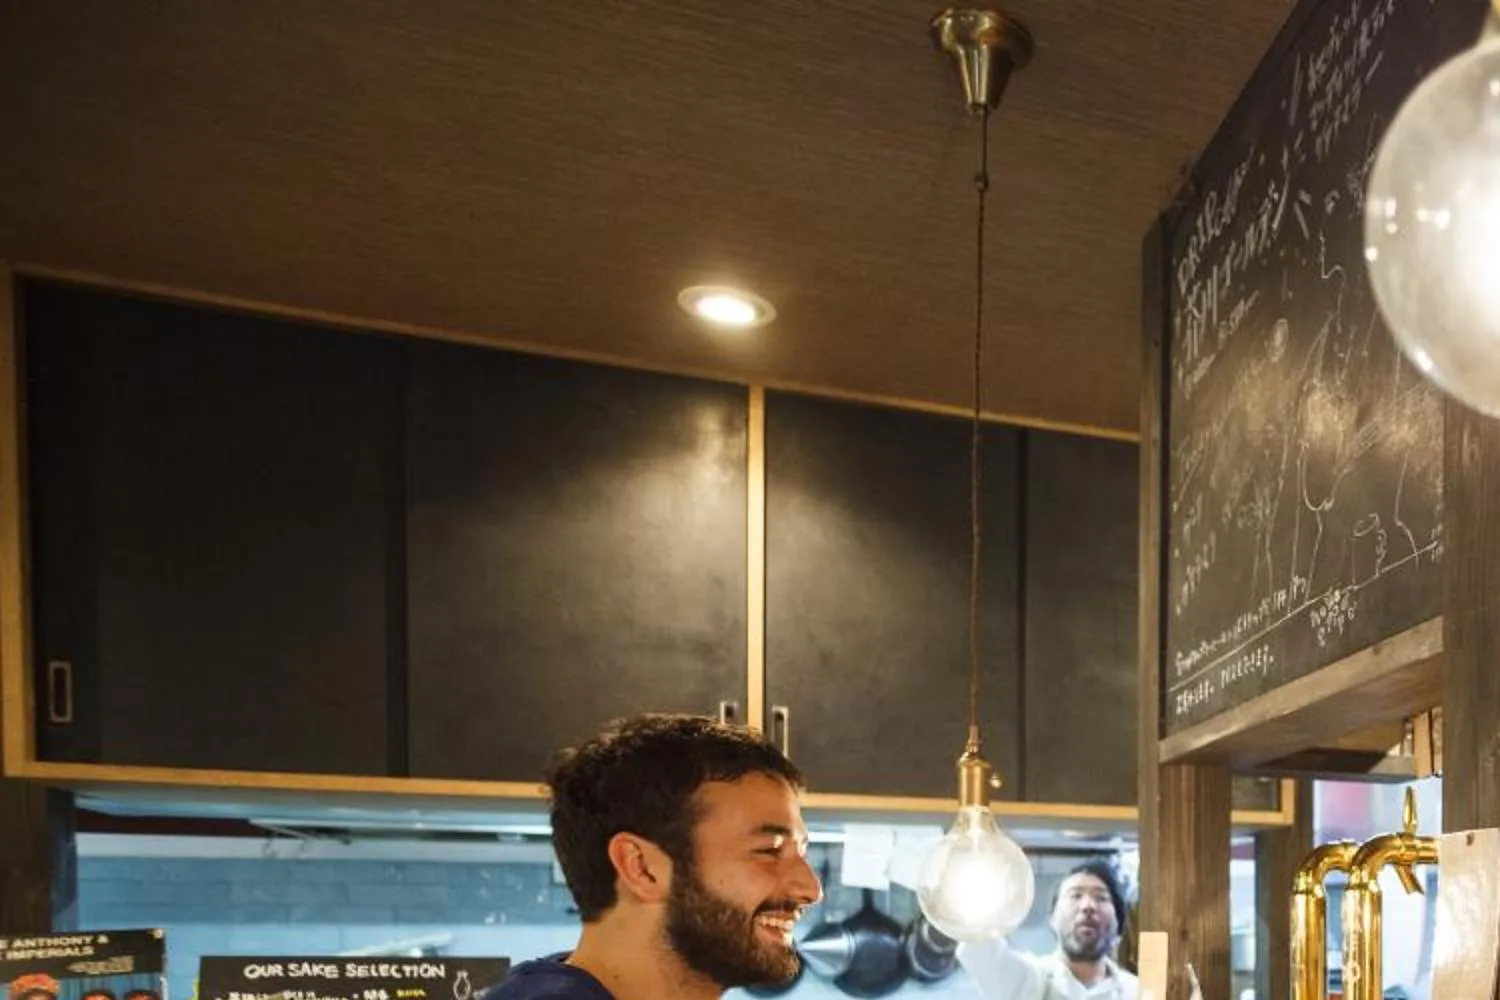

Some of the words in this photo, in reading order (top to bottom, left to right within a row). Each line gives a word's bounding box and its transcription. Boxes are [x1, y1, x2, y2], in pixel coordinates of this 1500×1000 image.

[12, 935, 95, 949] ANTHONY
[243, 963, 284, 979] OUR
[287, 962, 340, 979] SAKE
[344, 962, 446, 979] SELECTION
